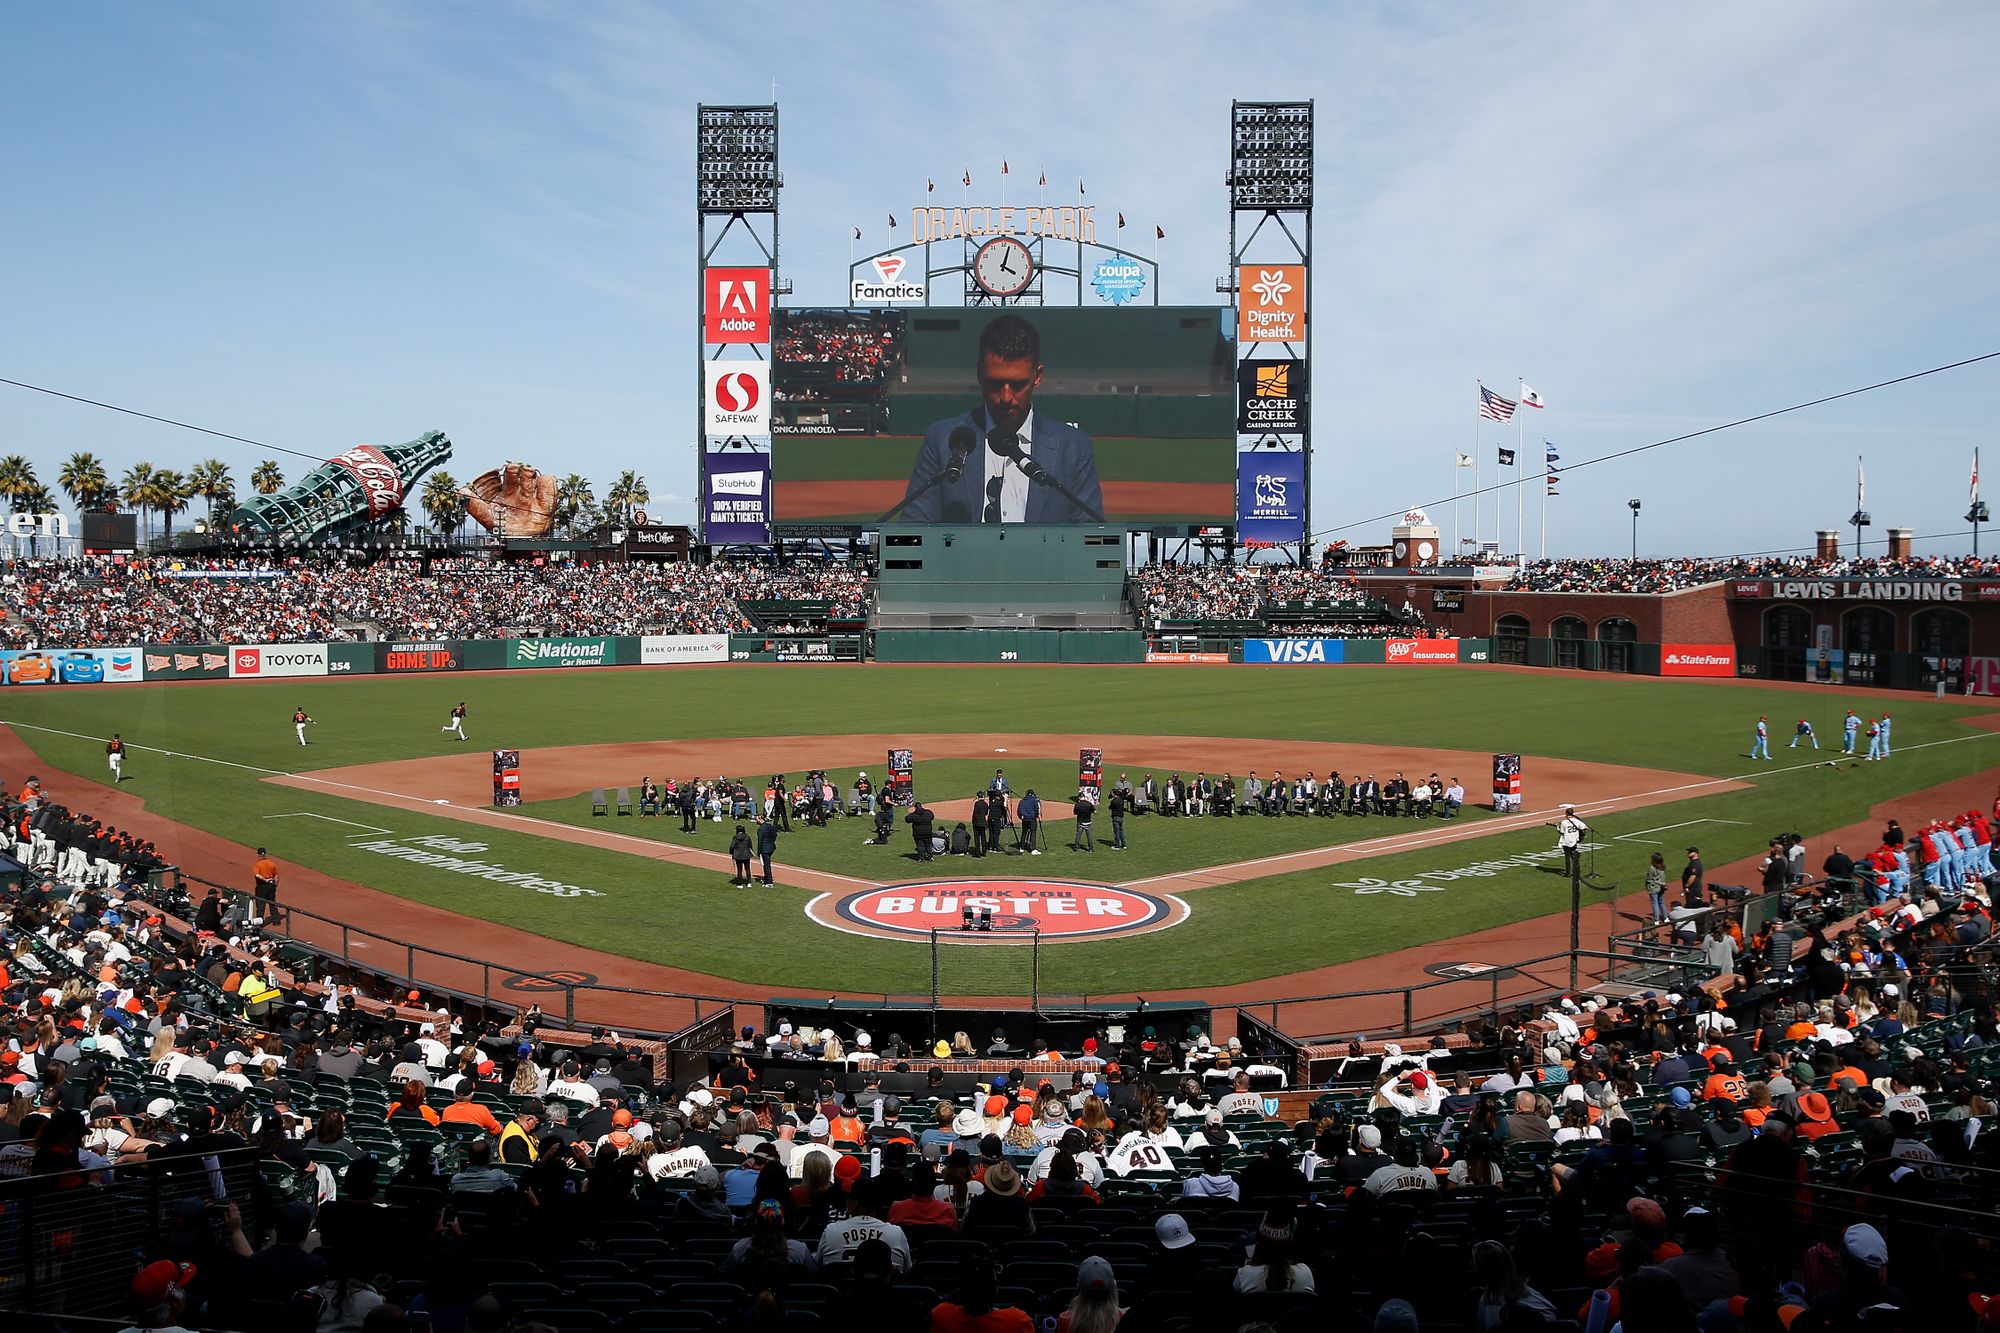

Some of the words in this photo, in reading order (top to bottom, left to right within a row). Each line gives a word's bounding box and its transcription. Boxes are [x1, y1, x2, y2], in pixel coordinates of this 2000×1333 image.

[912, 206, 1016, 245] ORACLE
[1026, 206, 1097, 245] PARK
[1099, 264, 1141, 279] coupa
[854, 283, 924, 299] Fanatics
[1247, 310, 1295, 325] Dignity
[720, 318, 756, 331] Adobe
[1246, 399, 1297, 409] CACHE
[715, 414, 759, 423] SAFEWAY
[1247, 410, 1295, 420] CREEK
[800, 426, 836, 434] MINOLTA
[718, 478, 756, 488] StubHub
[712, 500, 732, 511] 100%
[732, 500, 762, 511] VERIFIED
[710, 512, 735, 523] GIANTS
[736, 512, 764, 523] TICKETS
[655, 531, 675, 545] Coffee
[1843, 582, 1962, 601] LANDING
[392, 644, 414, 652] GIANTS
[415, 643, 445, 652] BASEBALL
[1262, 640, 1326, 662] VISA
[1390, 643, 1408, 655] AAA
[266, 654, 323, 666] TOYOTA
[386, 652, 427, 669] GAME
[431, 651, 451, 668] UP
[732, 651, 750, 660] 399
[1000, 651, 1017, 660] 391
[1413, 651, 1456, 659] Insurance
[1470, 652, 1487, 660] 415
[330, 662, 351, 671] 354
[561, 658, 574, 666] Car
[576, 657, 602, 666] Rental
[1741, 664, 1757, 674] 365
[1414, 855, 1540, 881] Dignity
[924, 889, 1014, 897] THANK
[1019, 889, 1073, 897] YOU
[875, 896, 1129, 916] BUSTER
[556, 1087, 576, 1097] POSEY
[1233, 1099, 1256, 1108] POSEY
[1900, 1098, 1920, 1109] POSEY
[1129, 1145, 1161, 1168] 40
[842, 1228, 884, 1245] POSEY
